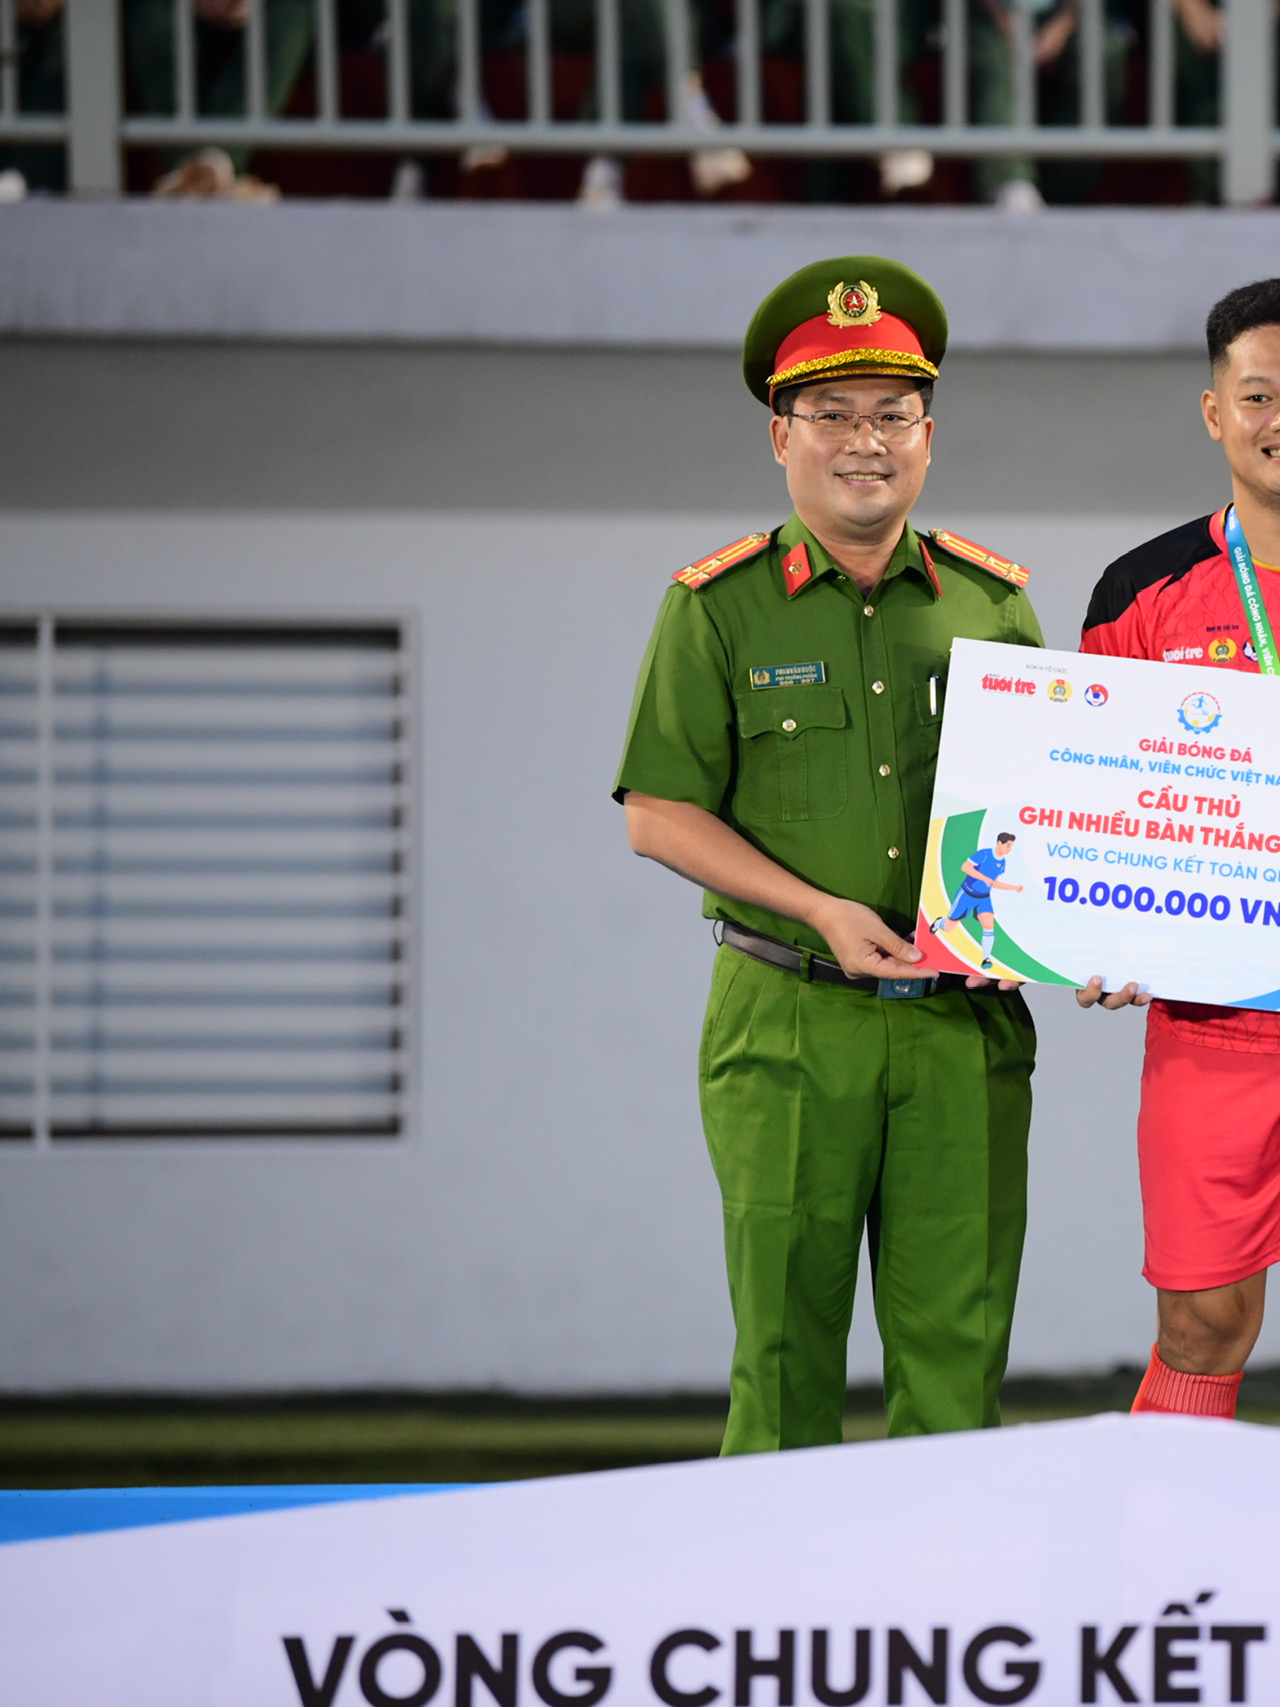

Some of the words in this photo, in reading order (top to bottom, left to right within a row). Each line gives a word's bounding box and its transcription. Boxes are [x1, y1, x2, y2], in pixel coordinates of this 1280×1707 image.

[1050, 748, 1095, 765] CÔNG
[1098, 755, 1144, 773] NHÂN,
[1148, 760, 1182, 775] VIÊN
[1184, 764, 1227, 780] CHỨC
[1230, 769, 1262, 786] VIỆT
[1138, 737, 1173, 755] GIẢI
[1176, 741, 1226, 760] BÓNG
[1229, 747, 1253, 763] ĐÁ
[1137, 785, 1188, 813] CẦU
[1194, 794, 1241, 818] THỦ
[1018, 806, 1063, 828] GHI
[1068, 810, 1140, 837] NHIỀU
[1145, 818, 1194, 843] BÀN
[1046, 841, 1099, 862] VÒNG
[1104, 850, 1168, 870] CHUNG
[1173, 854, 1205, 874] KẾT
[1209, 861, 1258, 880] TOÀN
[1043, 876, 1231, 921] 10.000.000
[281, 1609, 613, 1707] VÒNG
[649, 1625, 1042, 1707] CHUNG
[1080, 1590, 1267, 1704] KẾT
